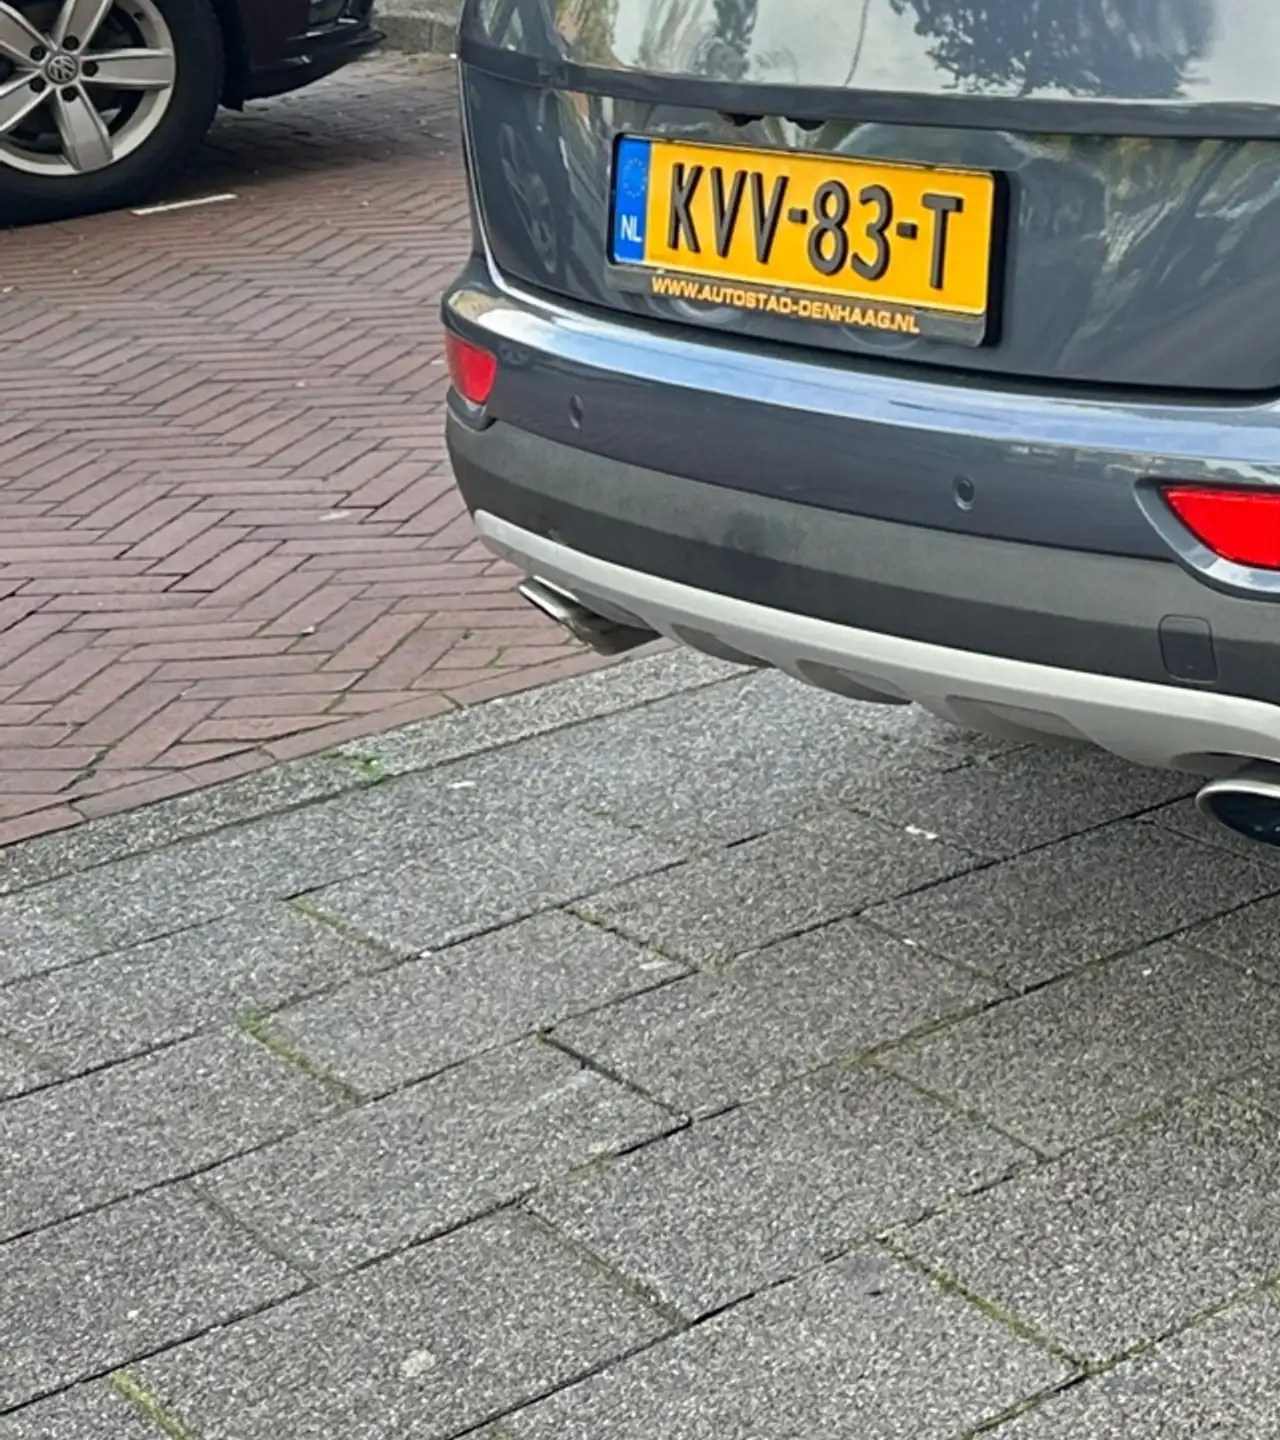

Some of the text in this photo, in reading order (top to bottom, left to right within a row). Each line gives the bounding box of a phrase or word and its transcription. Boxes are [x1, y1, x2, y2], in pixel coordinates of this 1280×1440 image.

[620, 213, 643, 243] NL
[667, 162, 965, 290] KVV-83-T
[651, 275, 921, 334] WWW.AUTOSTAD-DENHAAG.NL
